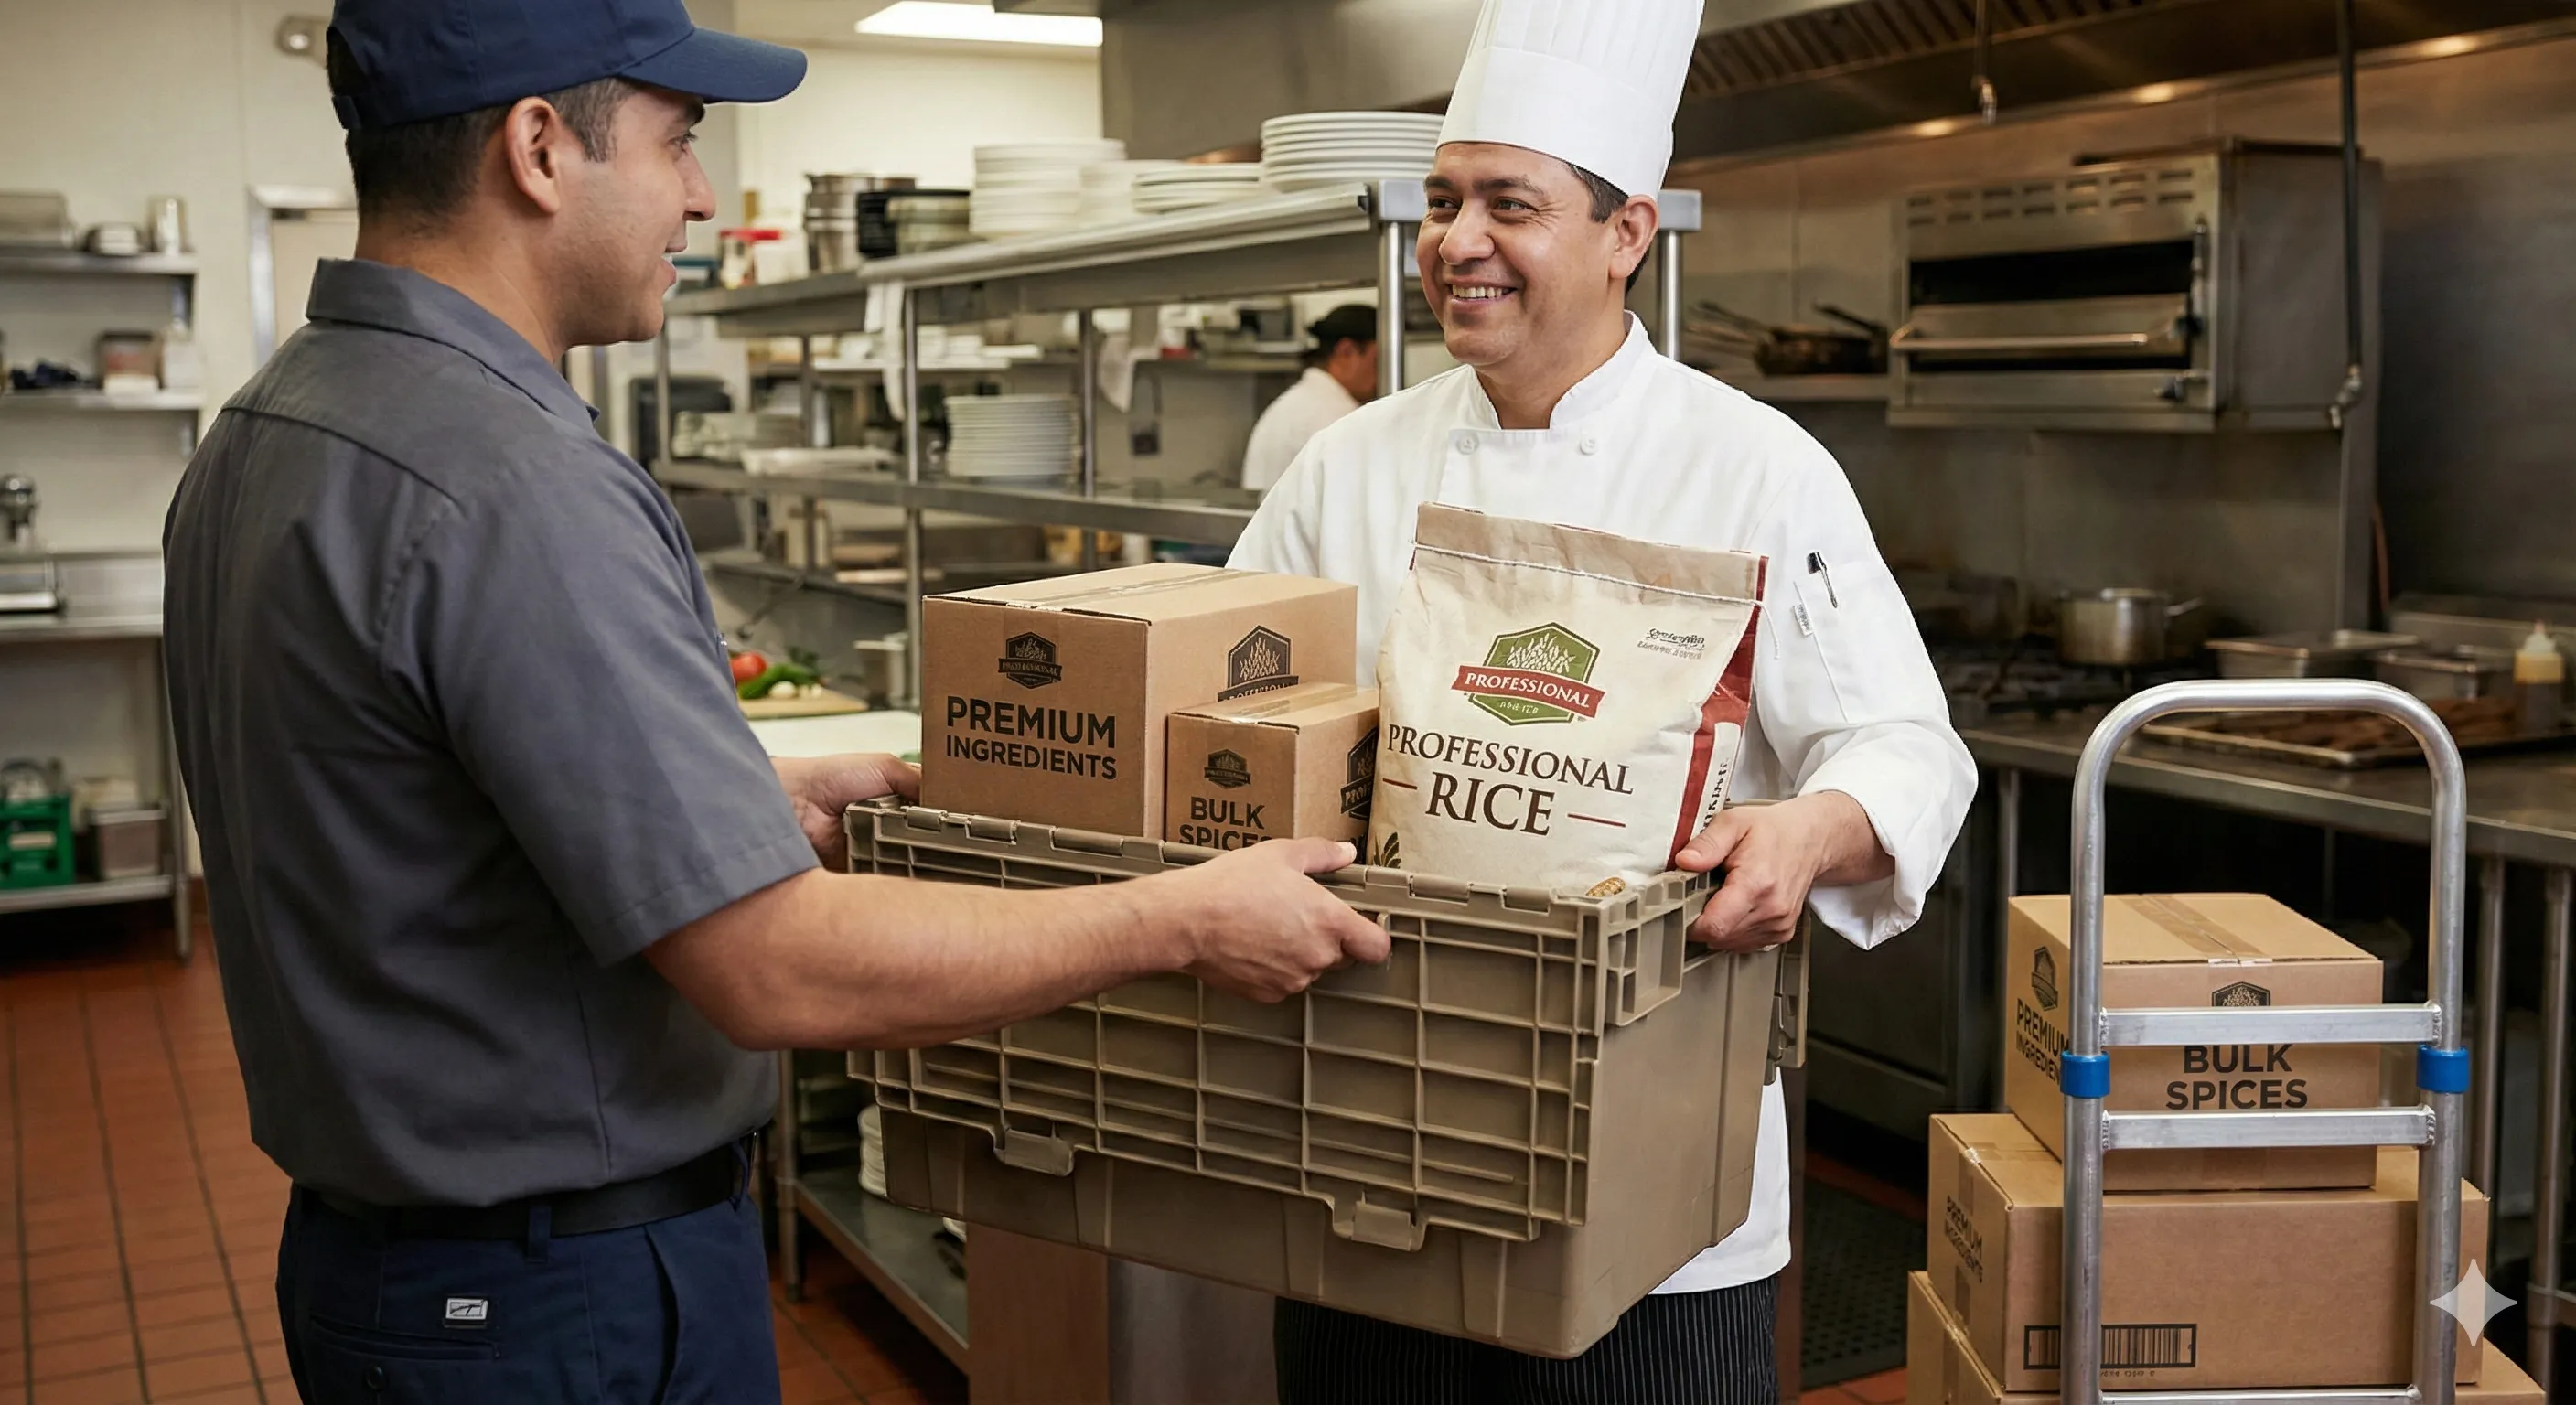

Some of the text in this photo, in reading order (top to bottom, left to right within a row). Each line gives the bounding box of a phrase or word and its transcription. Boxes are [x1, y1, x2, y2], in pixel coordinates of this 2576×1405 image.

[1465, 672, 1590, 708] PROFESSIONAL
[947, 695, 1116, 748] PREMIUM
[946, 735, 1117, 780] INGREDIENTS
[1387, 724, 1634, 795] PROFESSIONAL
[1190, 796, 1265, 830] BULK
[1425, 771, 1555, 836] RICE
[1179, 824, 1272, 852] SPICE
[2184, 1044, 2292, 1074] BULK
[2165, 1079, 2308, 1110] SPICES
